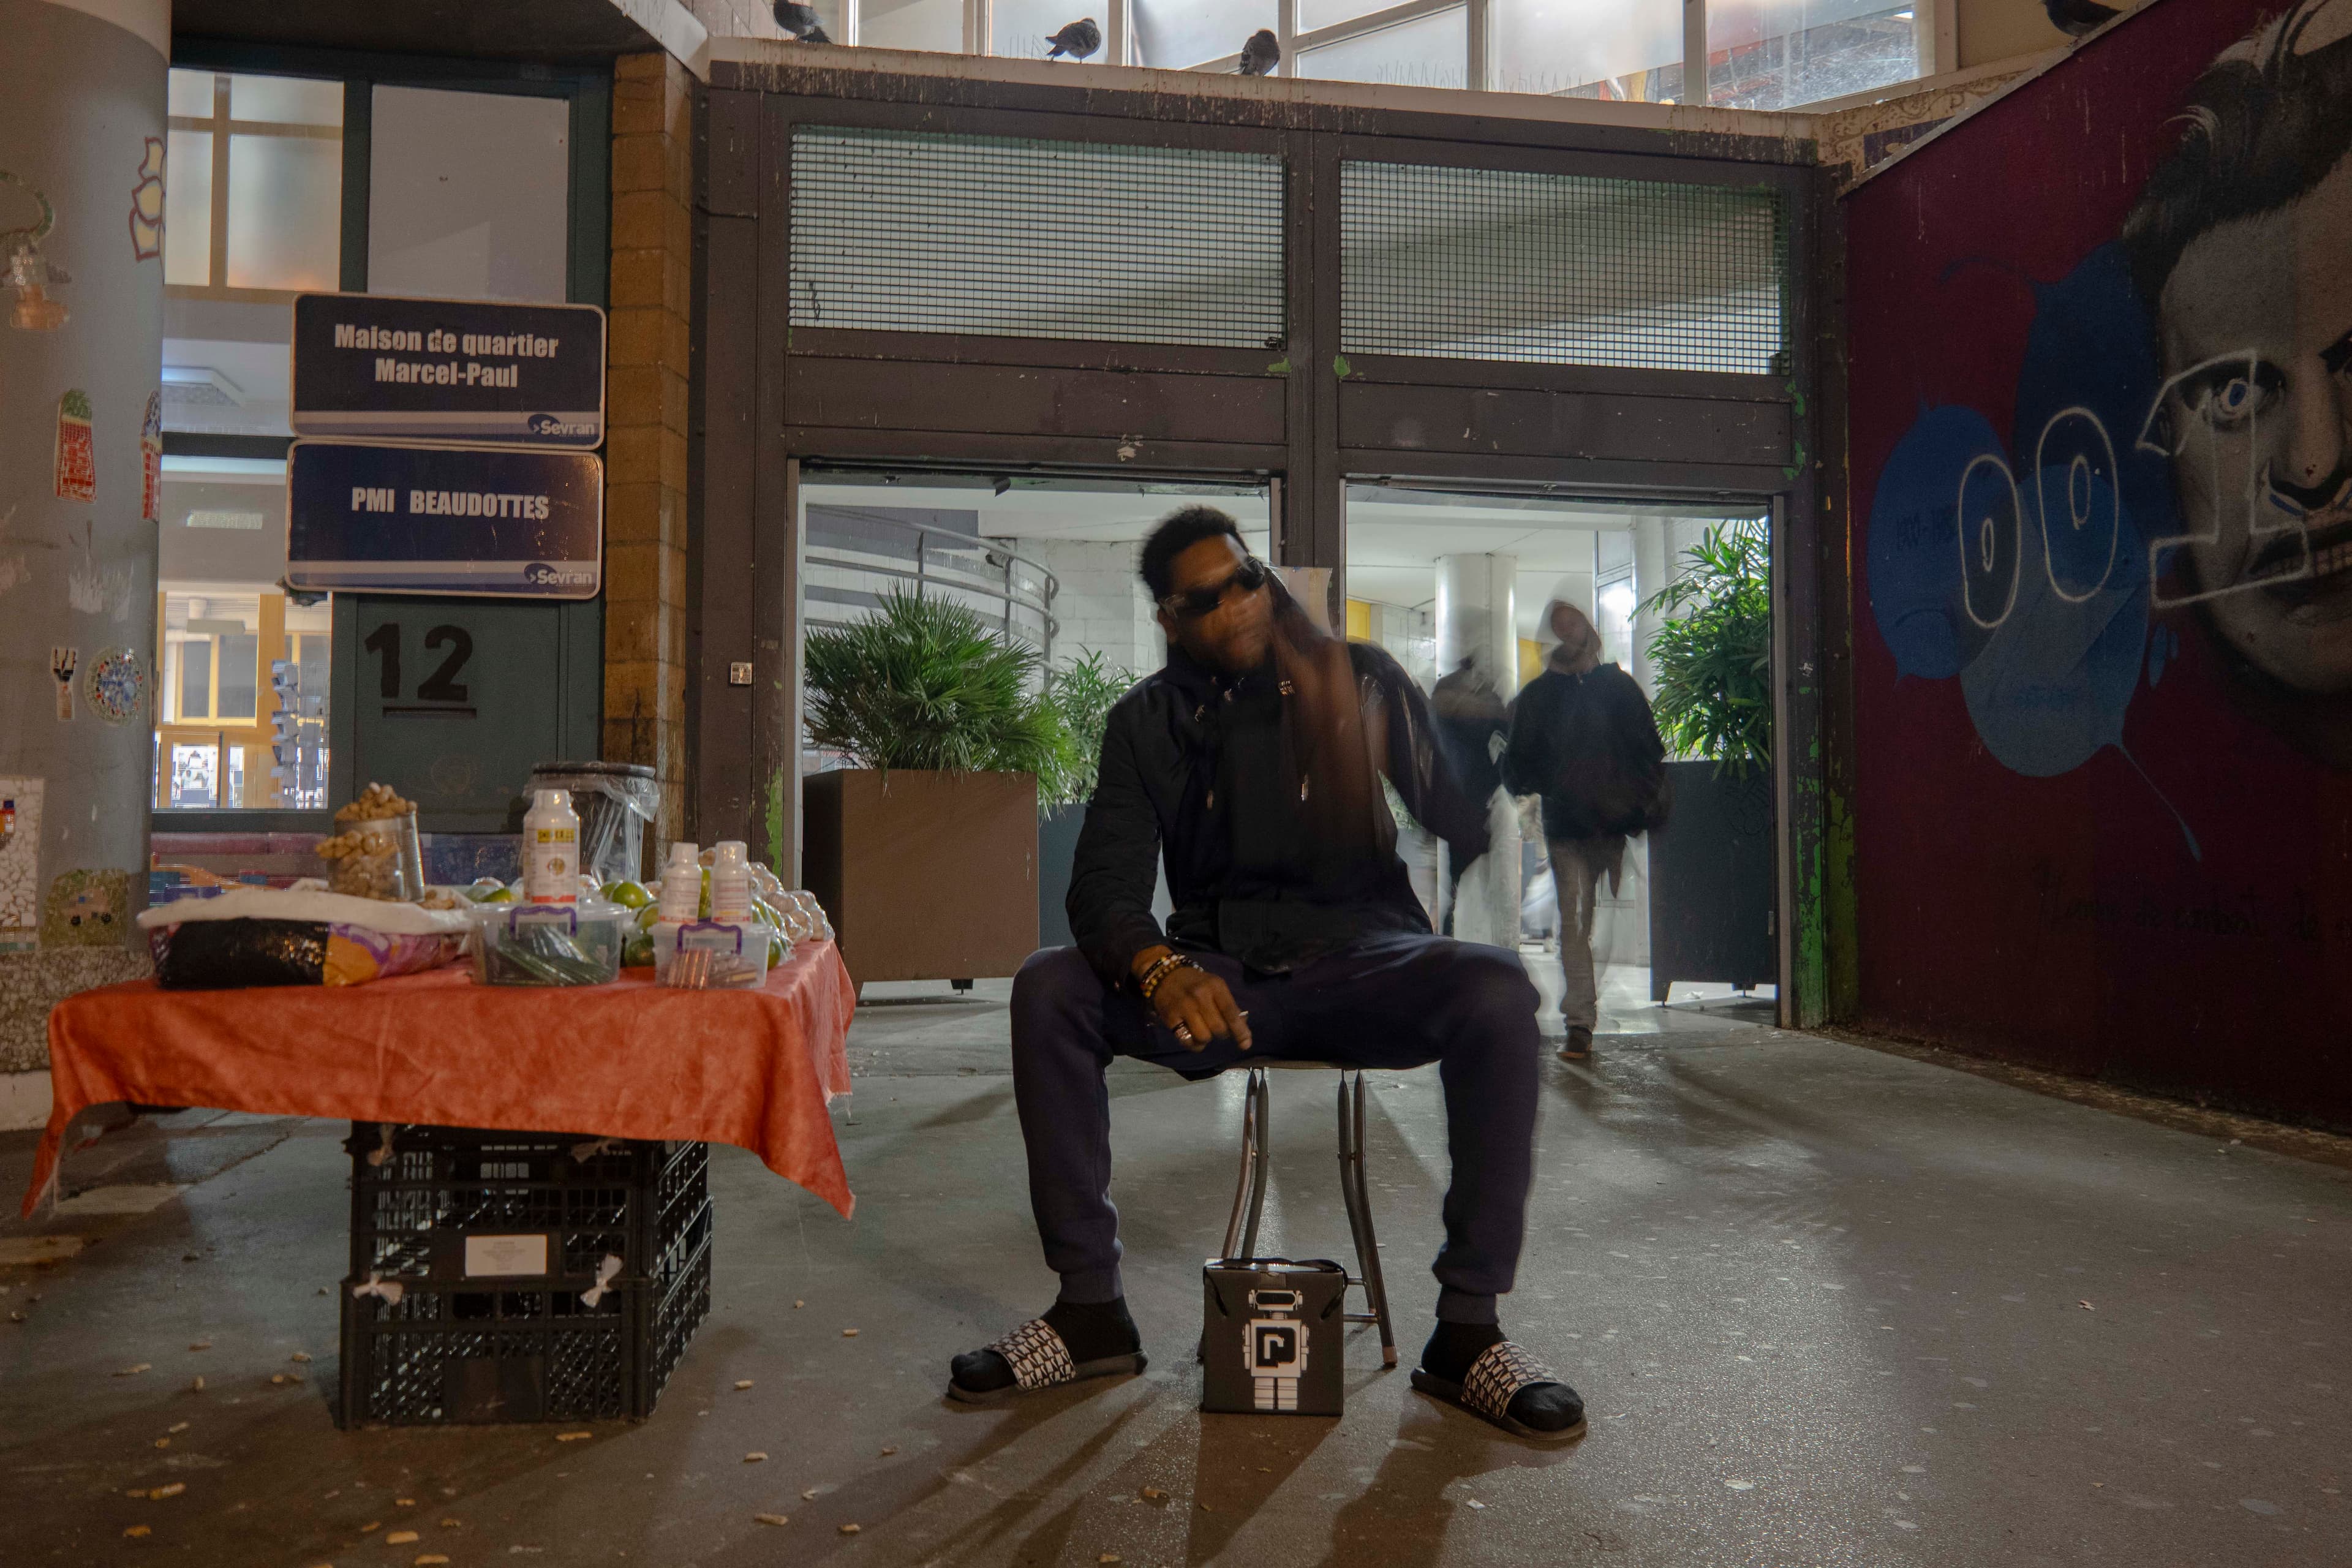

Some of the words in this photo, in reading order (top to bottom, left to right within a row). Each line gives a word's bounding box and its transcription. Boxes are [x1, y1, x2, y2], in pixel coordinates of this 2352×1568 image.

[335, 324, 421, 351] Maison
[427, 329, 456, 353] de
[462, 333, 559, 358] quartier
[375, 358, 518, 387] Marcel-Paul
[541, 420, 595, 435] Sevran
[352, 488, 394, 513] PMI
[410, 490, 549, 519] BEAUDOTTES
[537, 568, 592, 584] Sevran
[364, 623, 473, 702] 12
